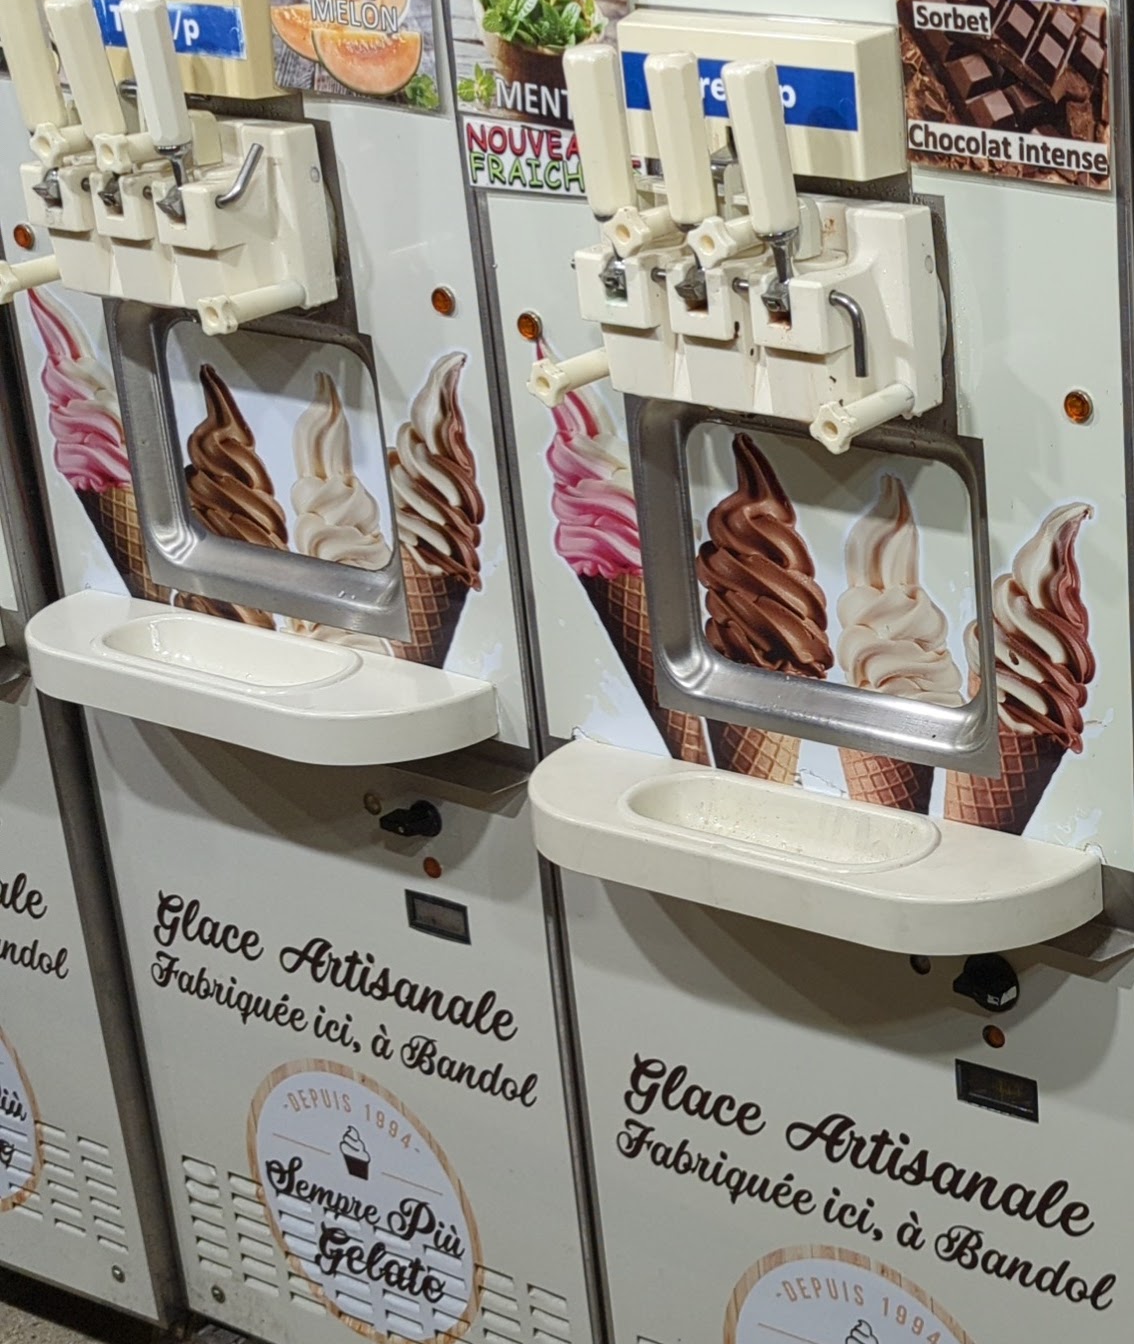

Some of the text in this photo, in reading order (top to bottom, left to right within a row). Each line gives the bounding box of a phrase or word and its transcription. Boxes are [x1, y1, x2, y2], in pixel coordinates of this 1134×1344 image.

[916, 5, 989, 34] Sorbet
[908, 123, 1109, 173] Chocolat intense
[155, 889, 518, 1041] Glace Artisanale
[151, 951, 538, 1108] Fabriquée ici, à Bandol
[266, 1158, 465, 1257] Sempre Più
[624, 1054, 1095, 1237] Glace Artisanale
[315, 1223, 446, 1304] Gelato
[617, 1119, 1117, 1311] Fabriquée ici, à Bandol
